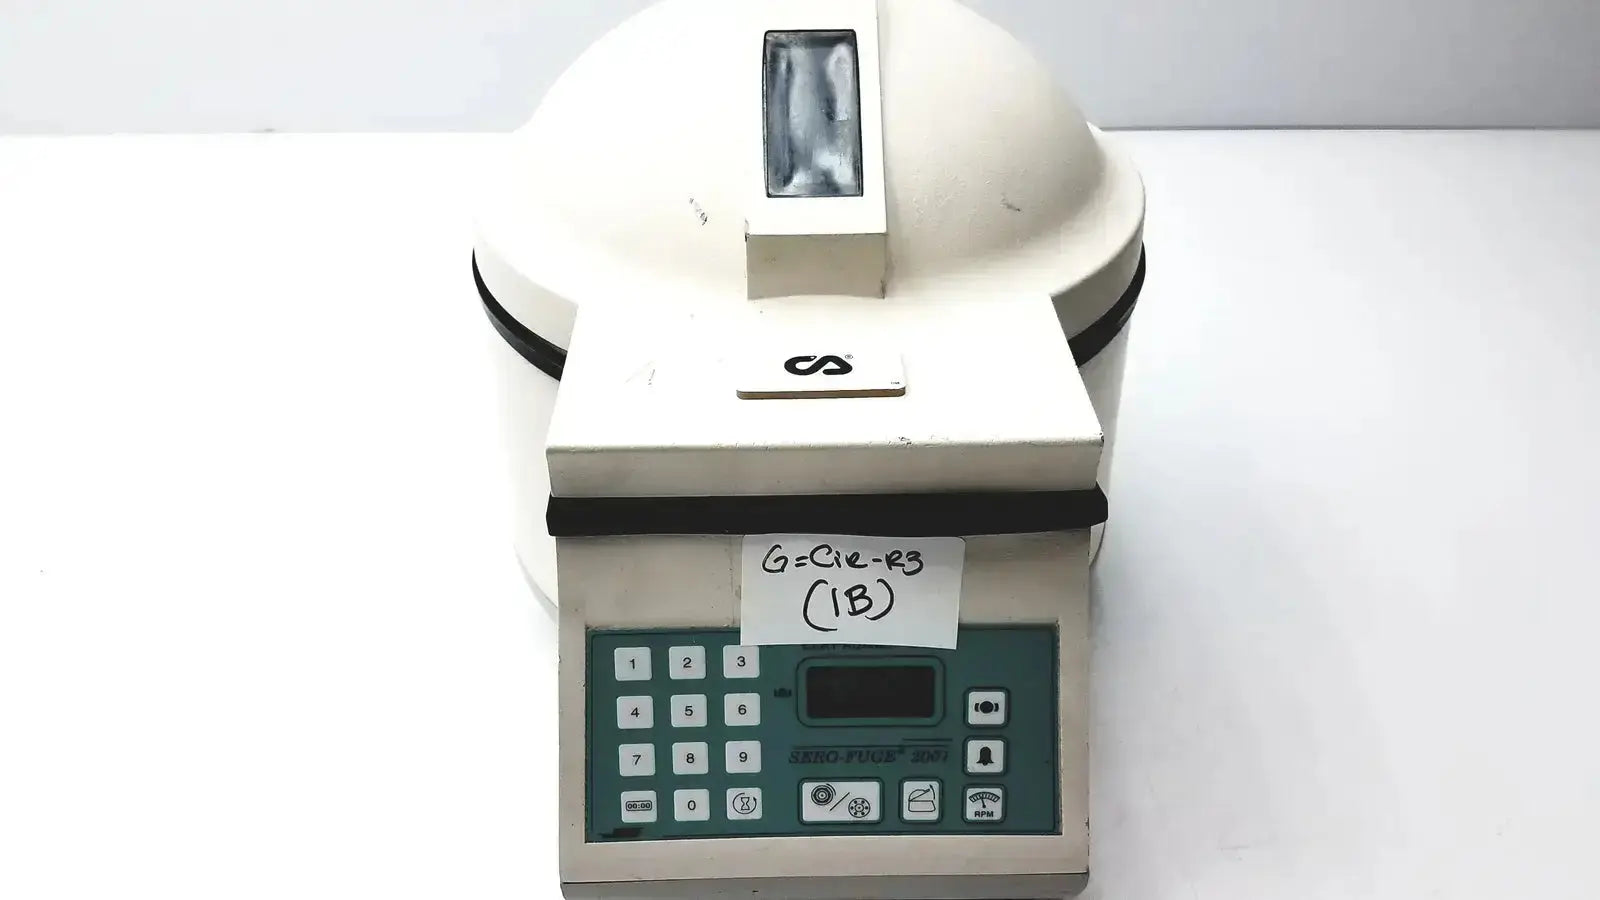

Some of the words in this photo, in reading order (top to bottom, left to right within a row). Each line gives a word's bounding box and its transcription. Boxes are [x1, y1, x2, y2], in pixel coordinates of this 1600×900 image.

[629, 658, 636, 670] 1
[682, 656, 693, 669] 2
[736, 655, 746, 668] 3
[630, 706, 640, 718] 4
[684, 705, 694, 717] 5
[737, 704, 747, 716] 6
[632, 754, 642, 766] 7
[685, 752, 695, 764] 8
[738, 751, 748, 763] 9
[687, 799, 697, 811] 0
[974, 810, 994, 818] RPM
